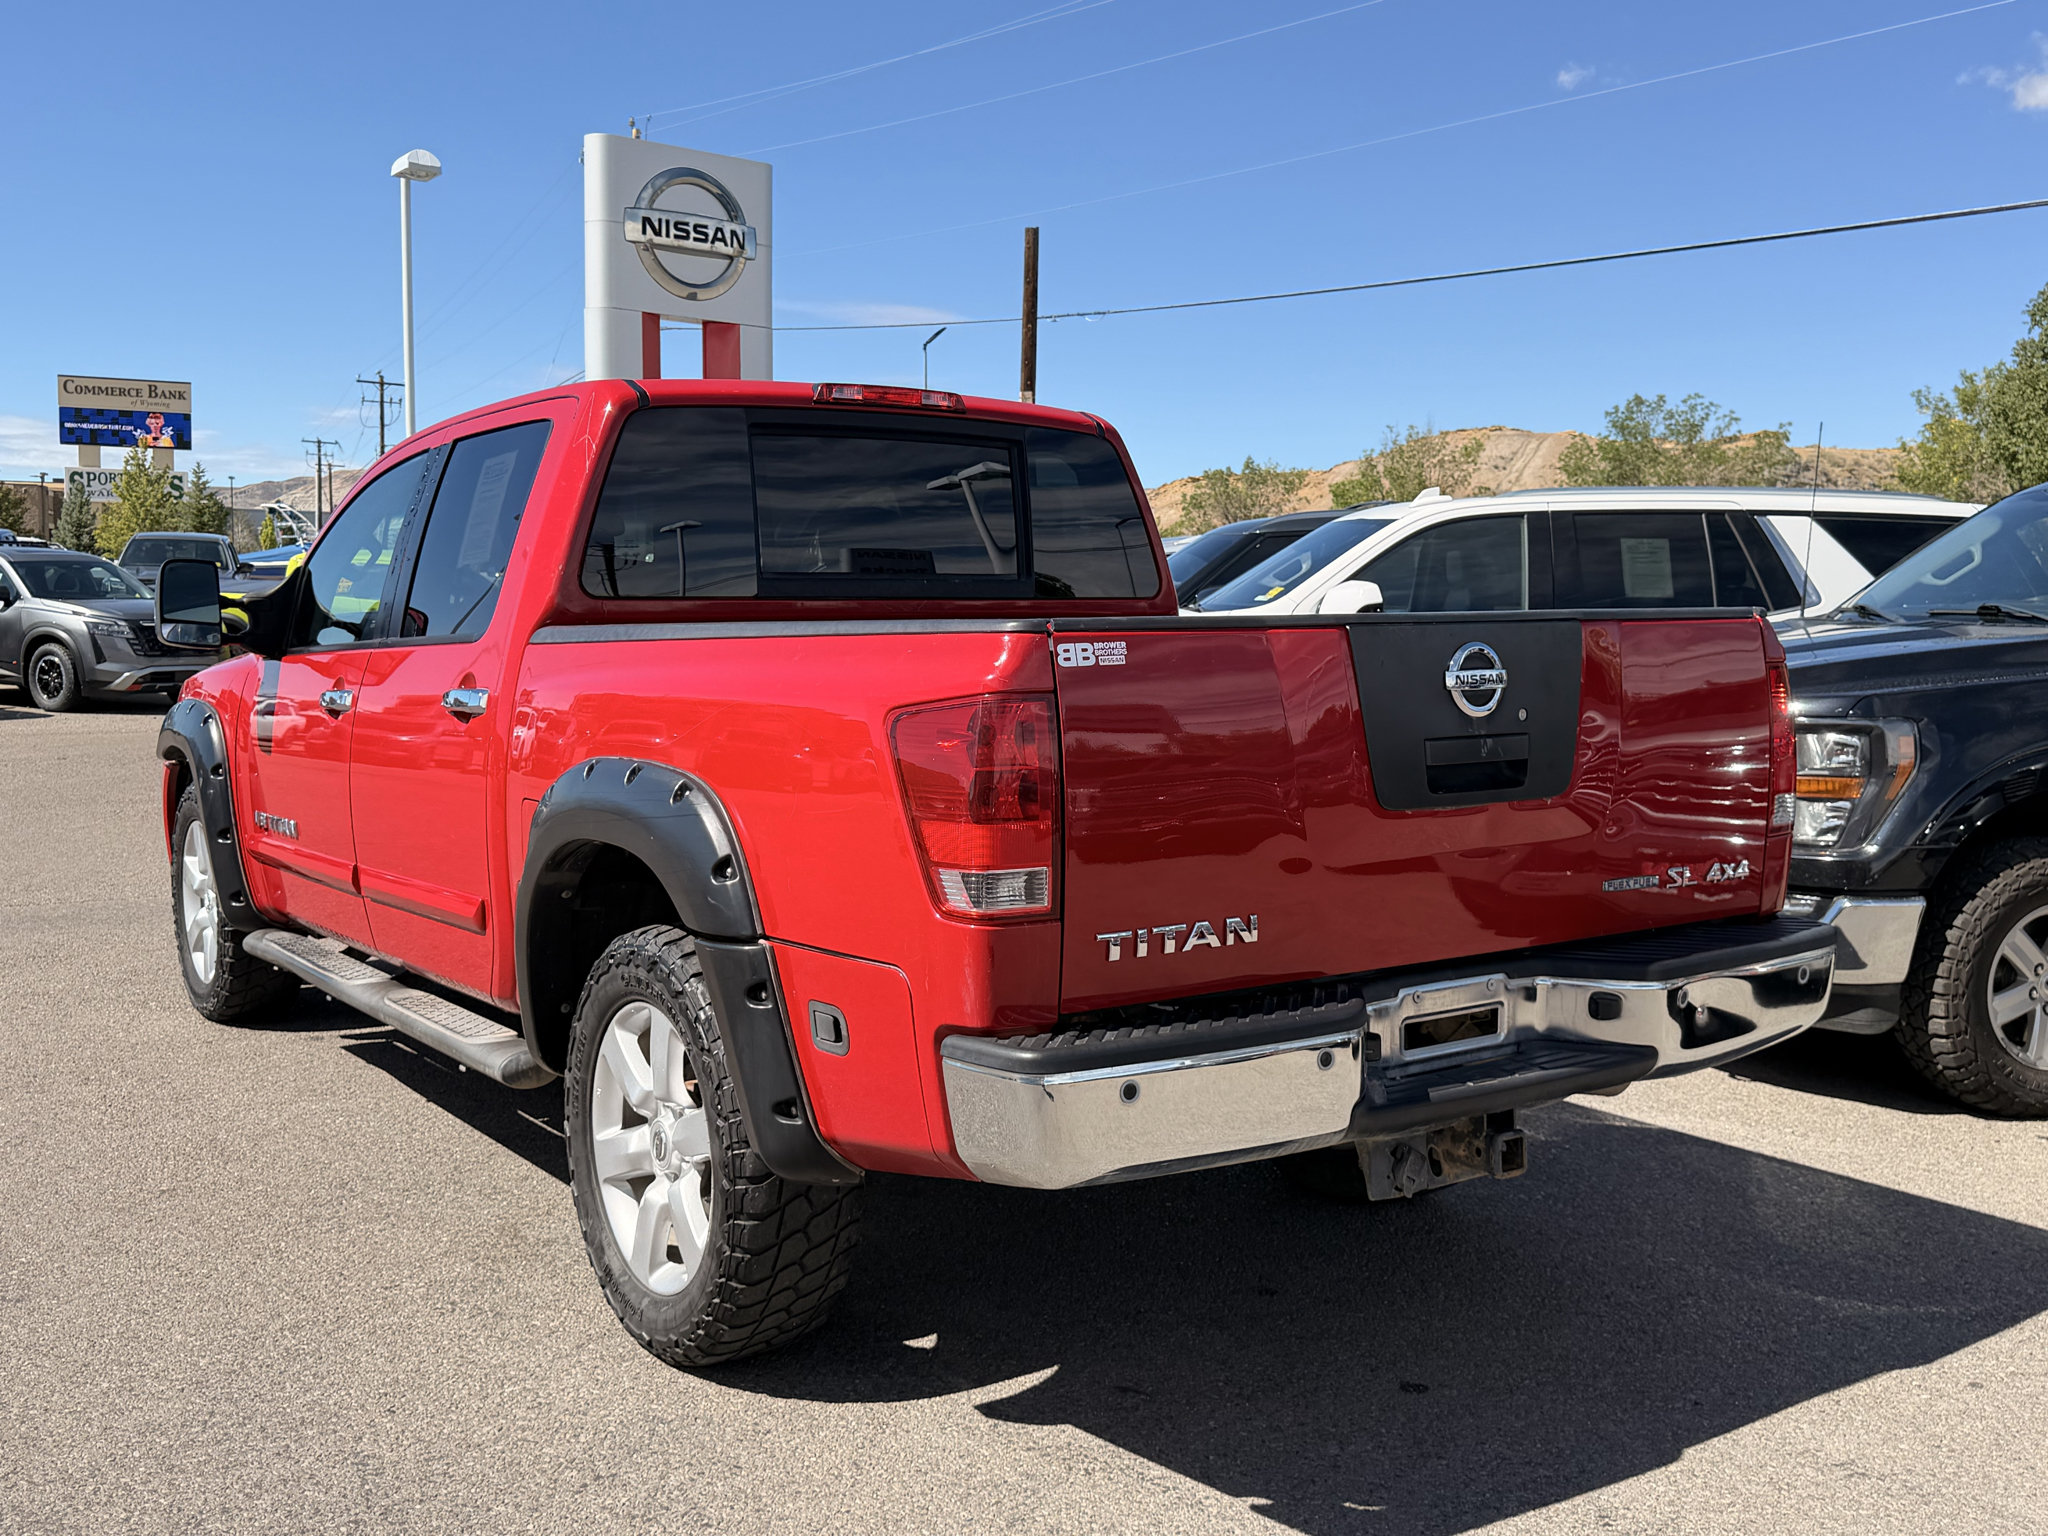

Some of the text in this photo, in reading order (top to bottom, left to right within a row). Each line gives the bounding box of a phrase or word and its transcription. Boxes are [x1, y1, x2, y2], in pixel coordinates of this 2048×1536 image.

[641, 216, 745, 250] NISSAN
[1455, 672, 1503, 685] NISSAN
[1666, 866, 1698, 889] SL
[1096, 914, 1259, 962] TITAN
